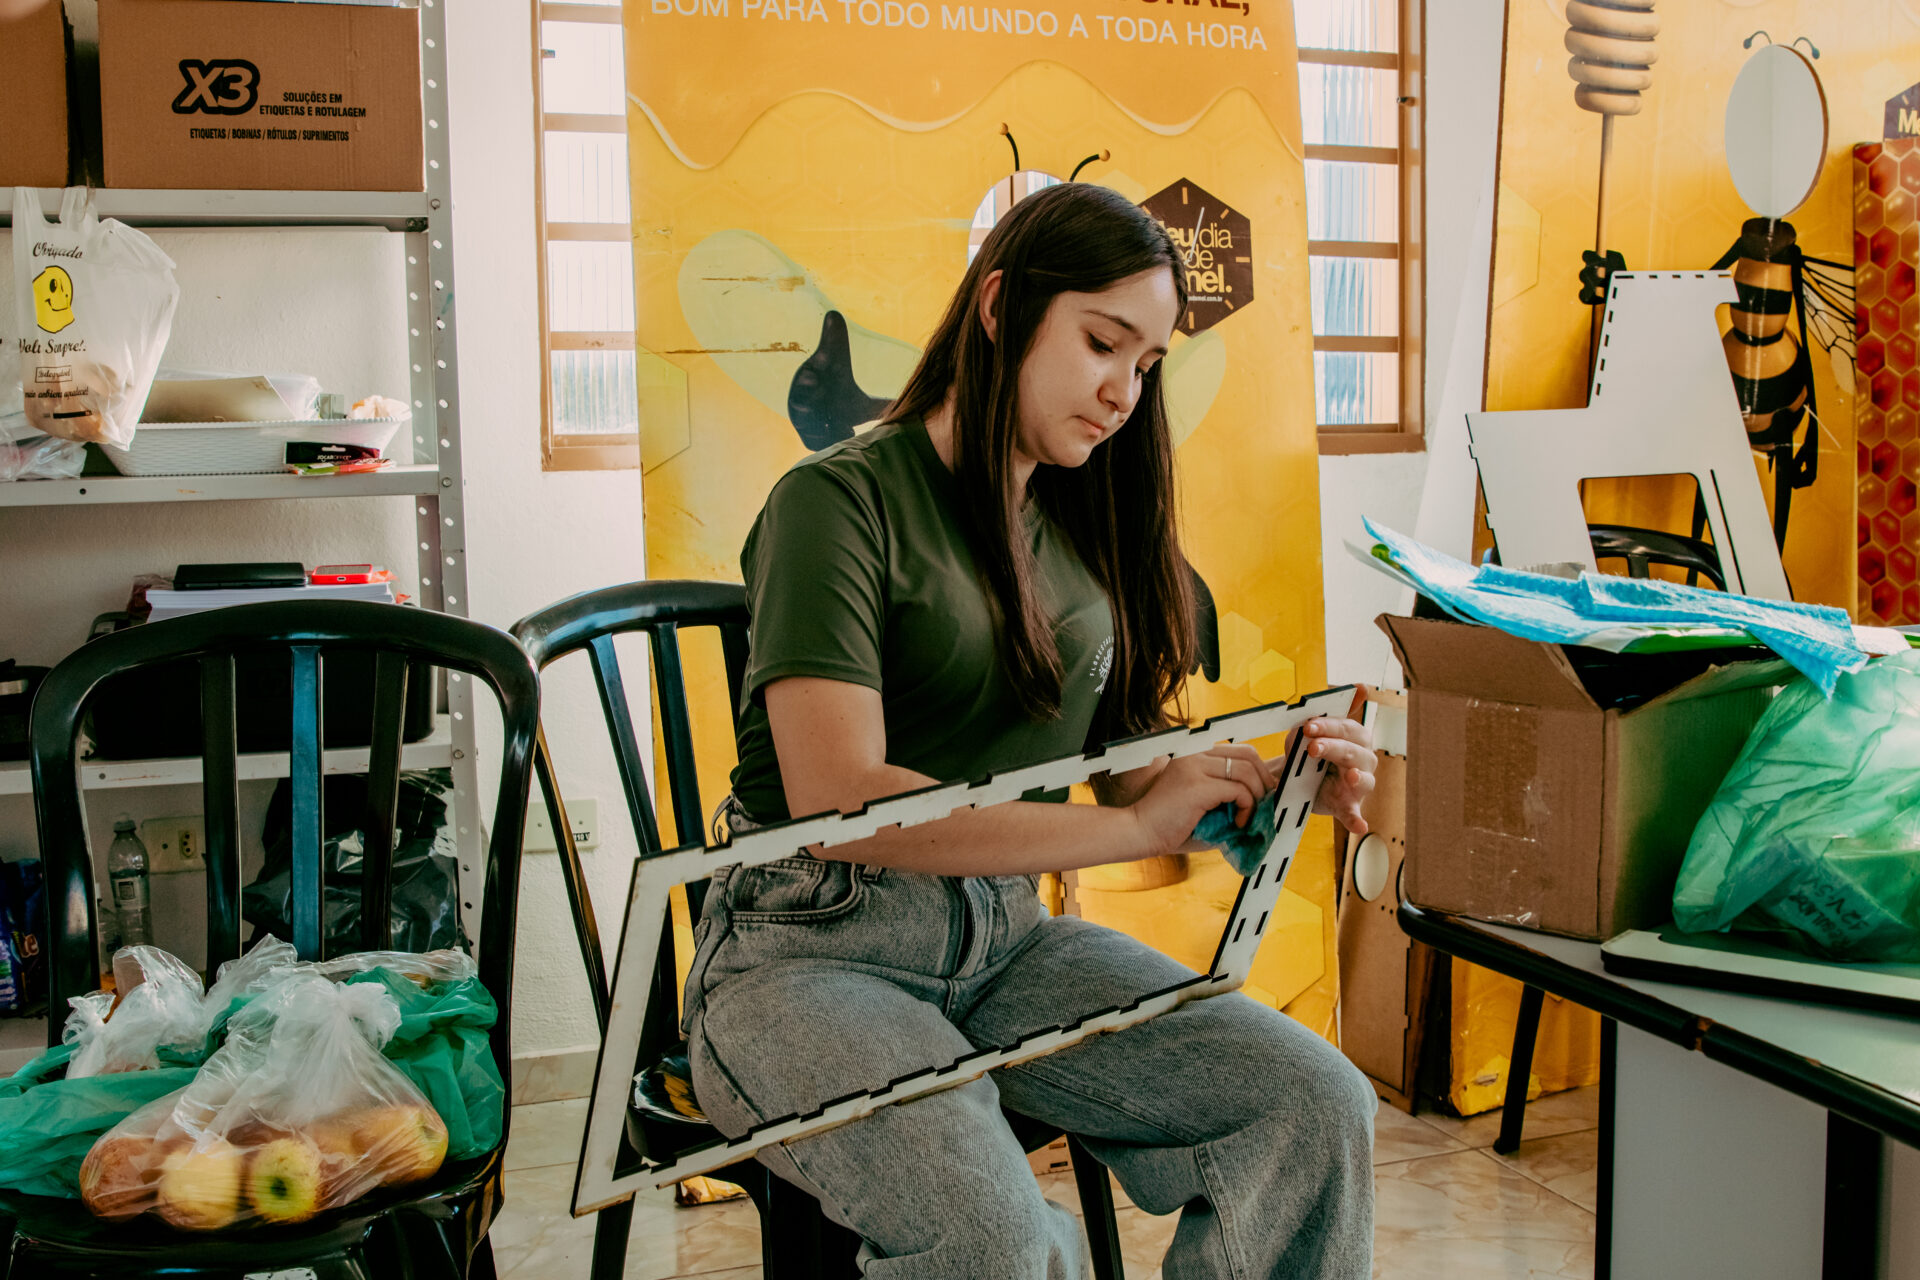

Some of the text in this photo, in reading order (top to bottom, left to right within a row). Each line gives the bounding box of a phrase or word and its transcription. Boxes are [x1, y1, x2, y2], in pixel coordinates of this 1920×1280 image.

[651, 0, 1267, 51] BOM PARA TODO MUNDO A TODA HORA
[172, 59, 260, 115] X3
[283, 91, 342, 104] SOLUÇÕES EM
[260, 105, 366, 117] ETIQUETAS E ROTULAGEM
[1899, 108, 1920, 135] M
[190, 128, 226, 139] ETIQUETAS
[232, 128, 261, 140] BOBINAS
[267, 127, 297, 140] RÓTULOS
[303, 130, 349, 141] SUPRIMENTOS
[1160, 221, 1233, 248] eu dia
